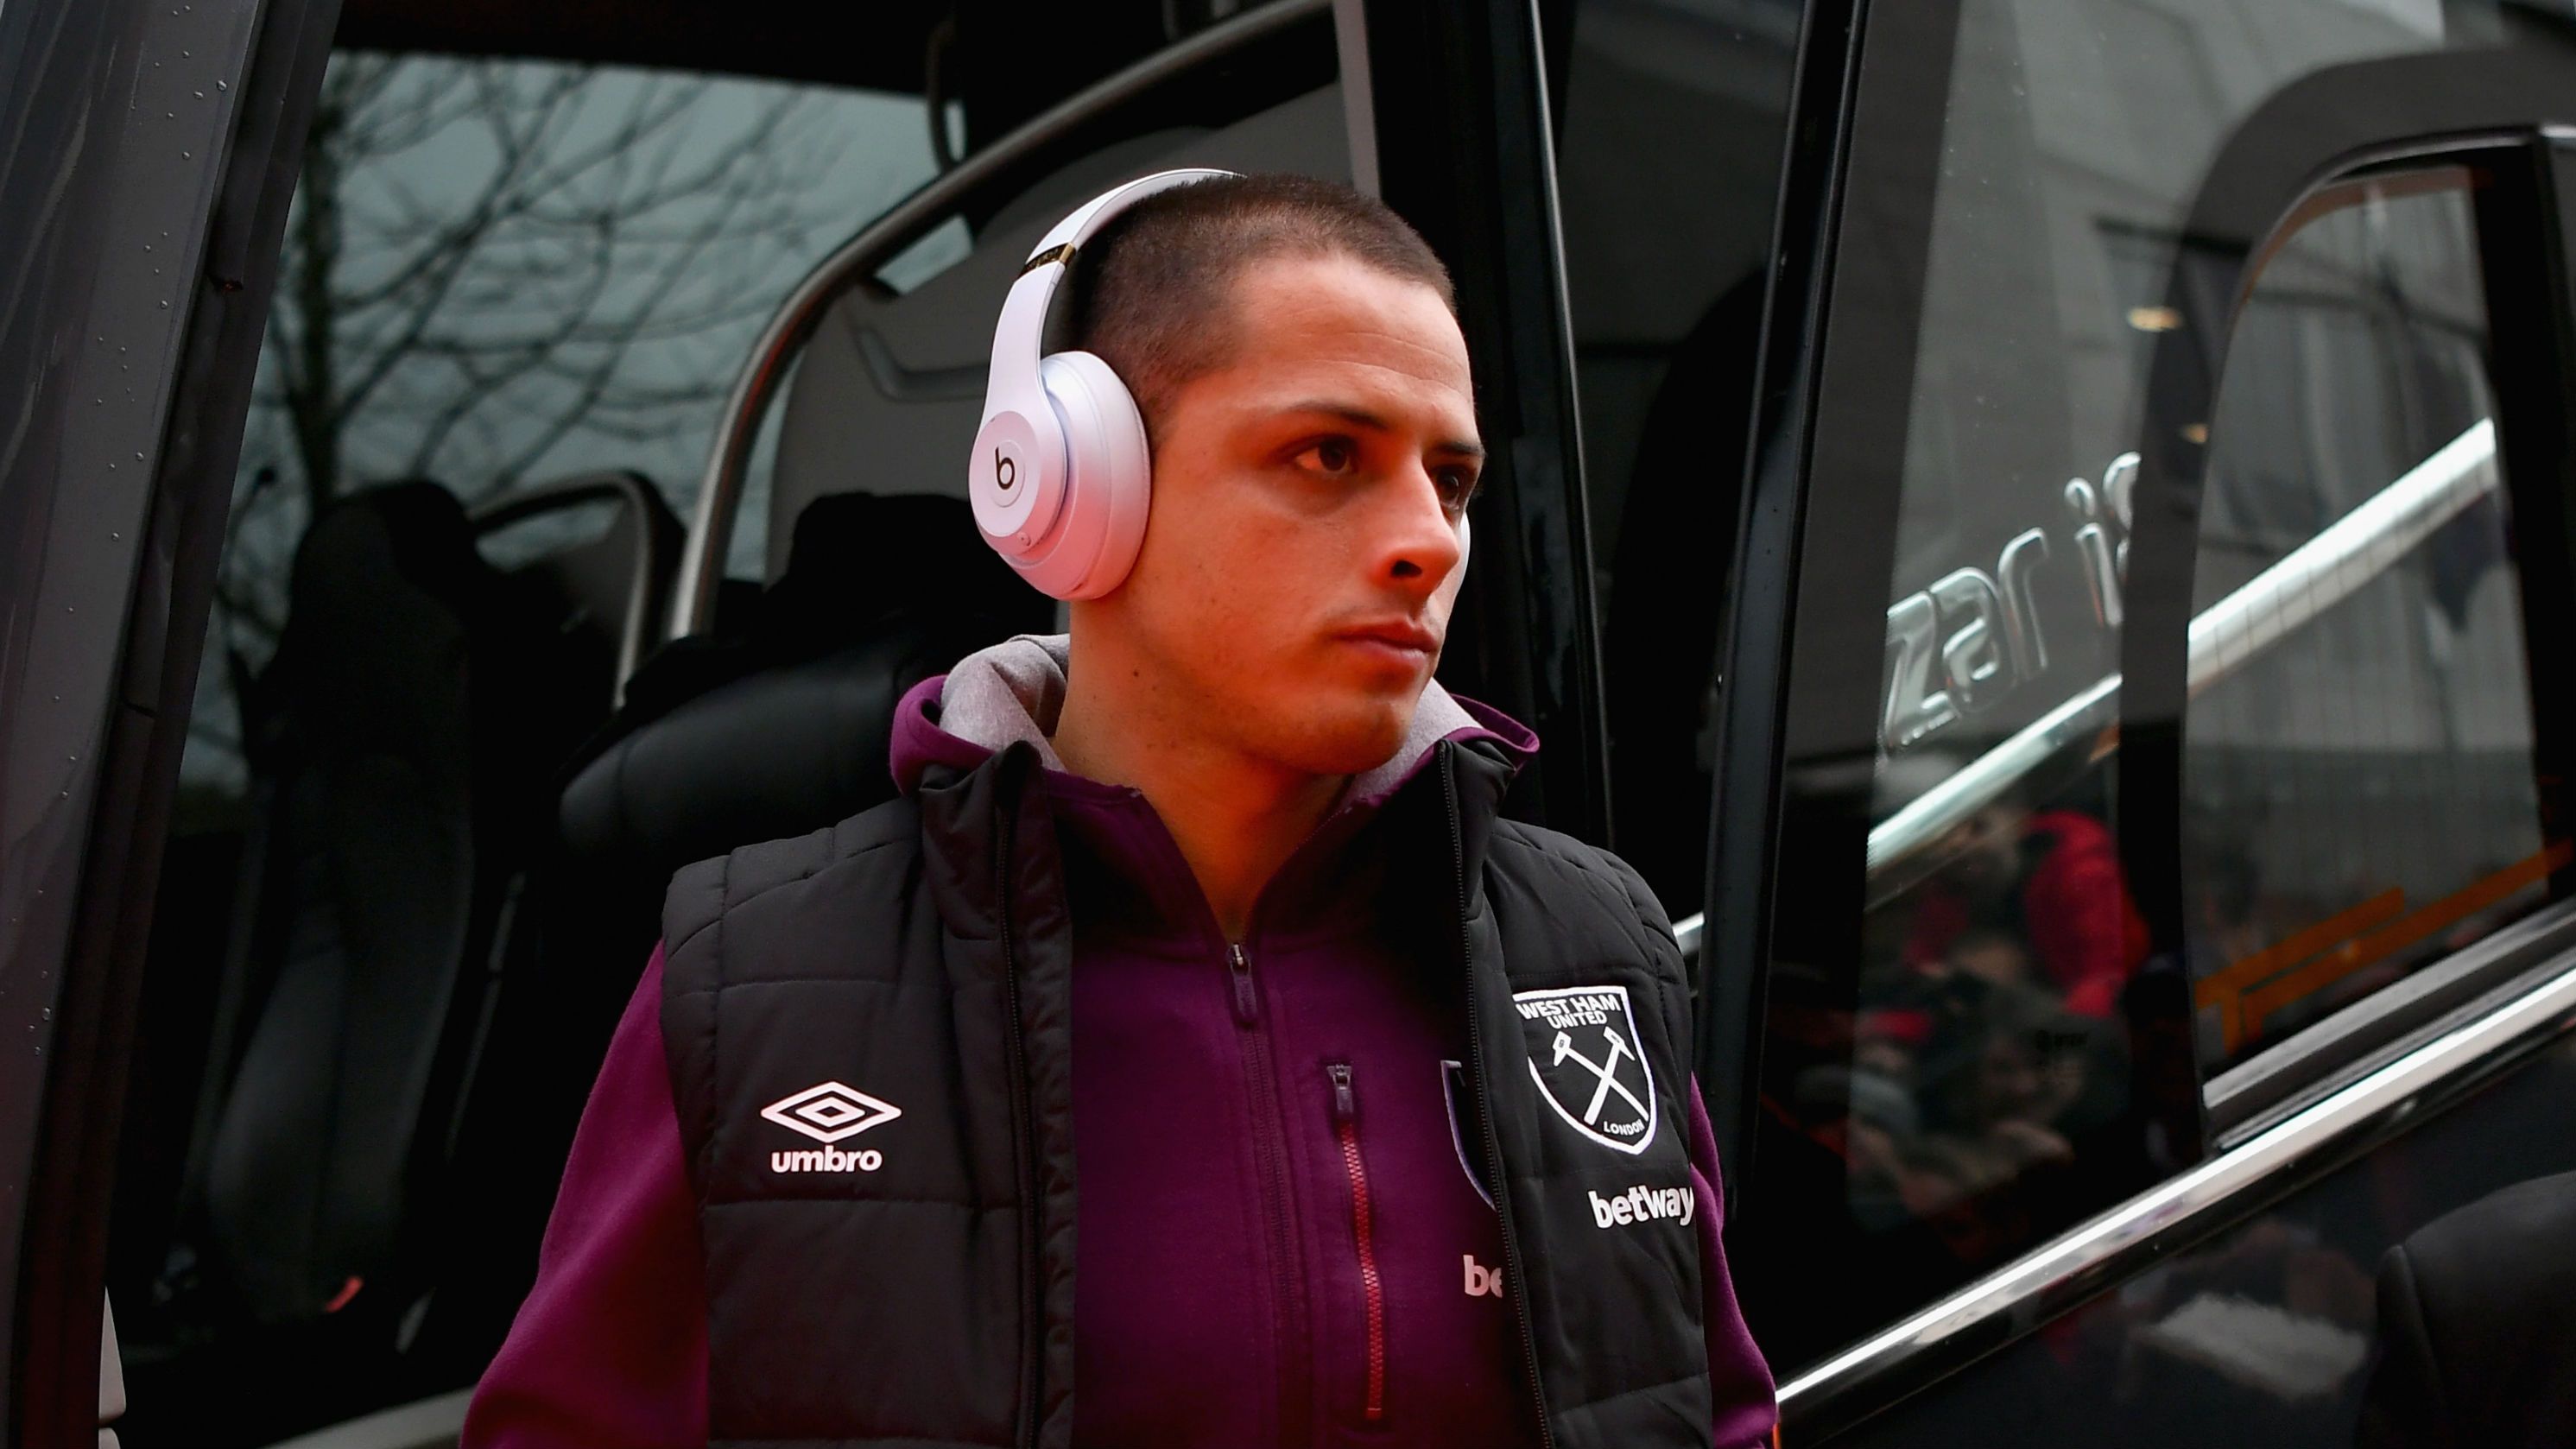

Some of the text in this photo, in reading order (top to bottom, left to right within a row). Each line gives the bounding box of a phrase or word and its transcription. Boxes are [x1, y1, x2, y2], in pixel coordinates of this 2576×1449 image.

[995, 446, 1016, 490] b
[1516, 994, 1621, 1020] WEST HAM
[1547, 1010, 1608, 1028] UNITED
[1603, 1118, 1645, 1136] LONDON
[772, 1145, 883, 1173] umbro
[1588, 1185, 1694, 1229] betway
